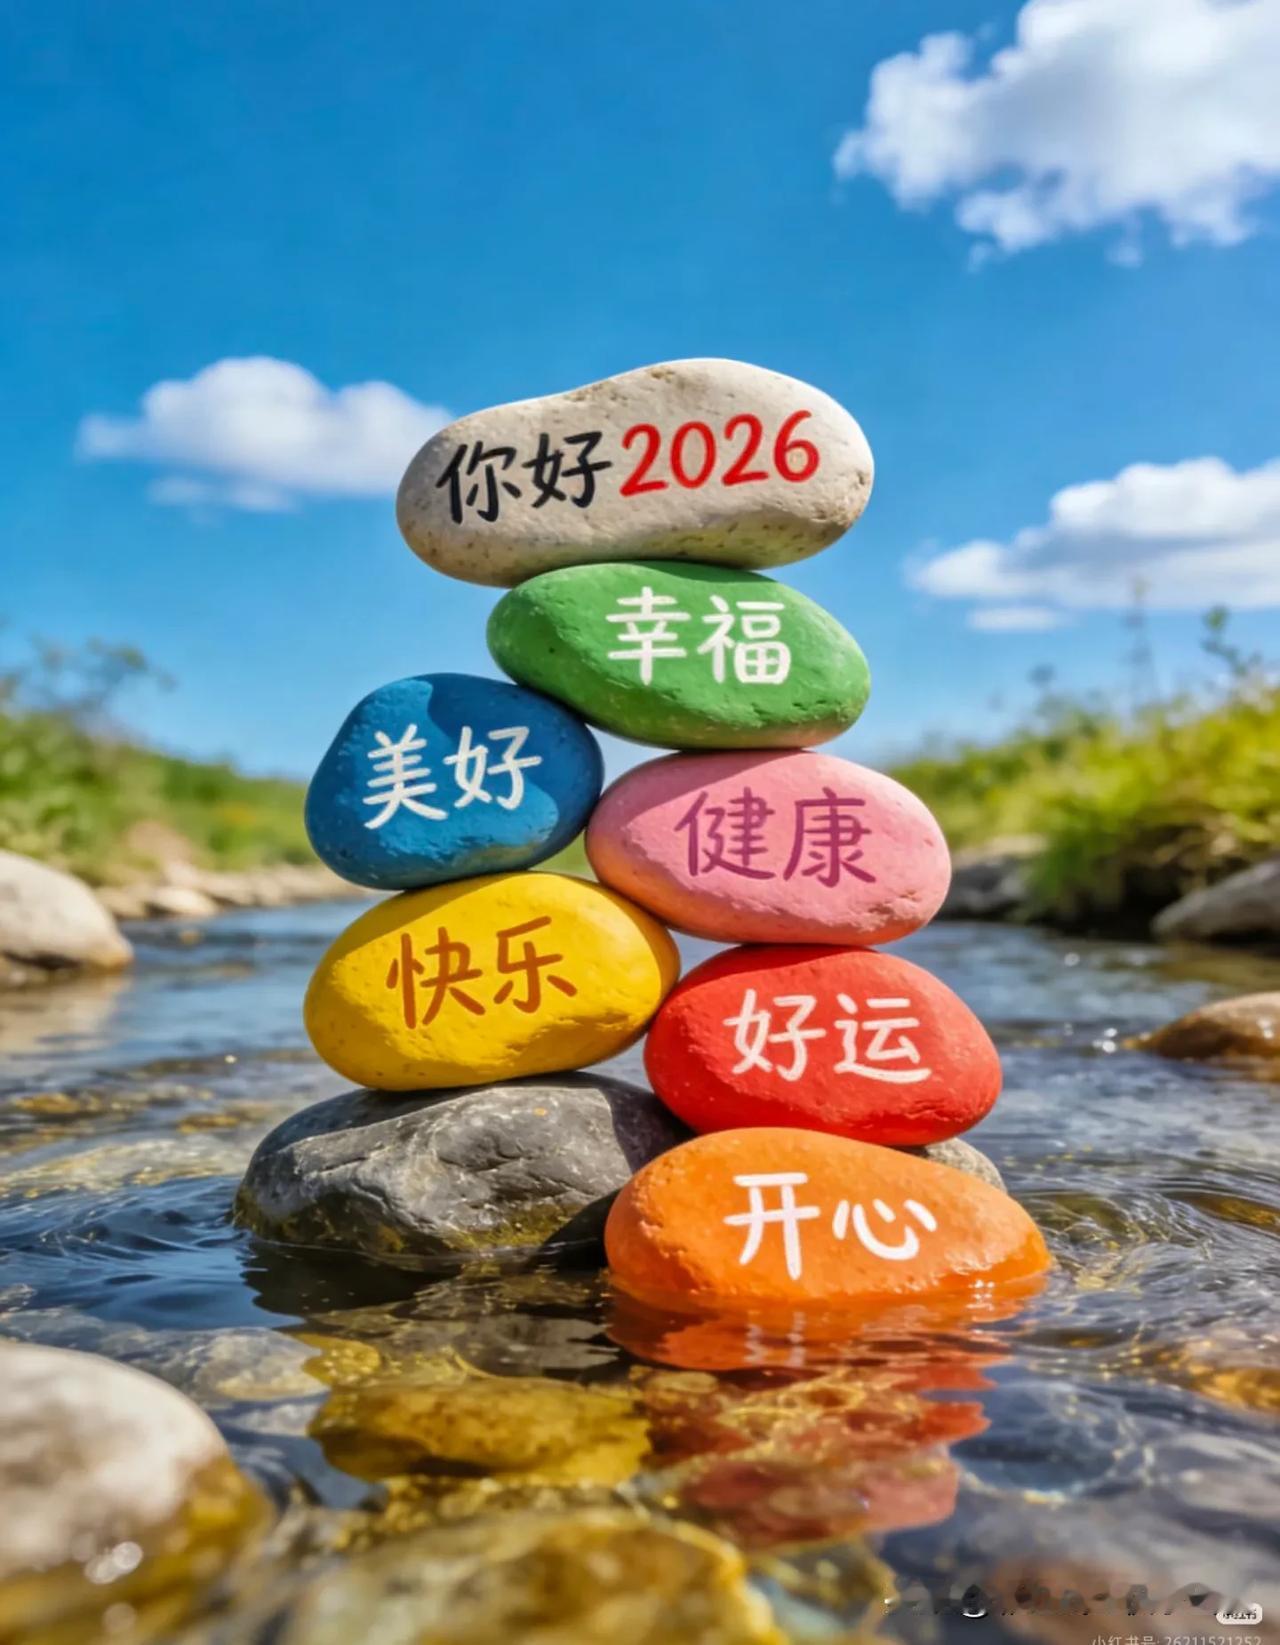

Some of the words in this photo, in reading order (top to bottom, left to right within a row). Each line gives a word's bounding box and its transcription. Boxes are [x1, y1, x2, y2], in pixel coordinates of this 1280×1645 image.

[605, 586, 792, 686] 幸福
[361, 724, 542, 830] 美好
[674, 786, 877, 888] 健康
[386, 916, 578, 1030] 快乐
[723, 988, 932, 1085] 好运
[723, 1171, 937, 1281] 开心
